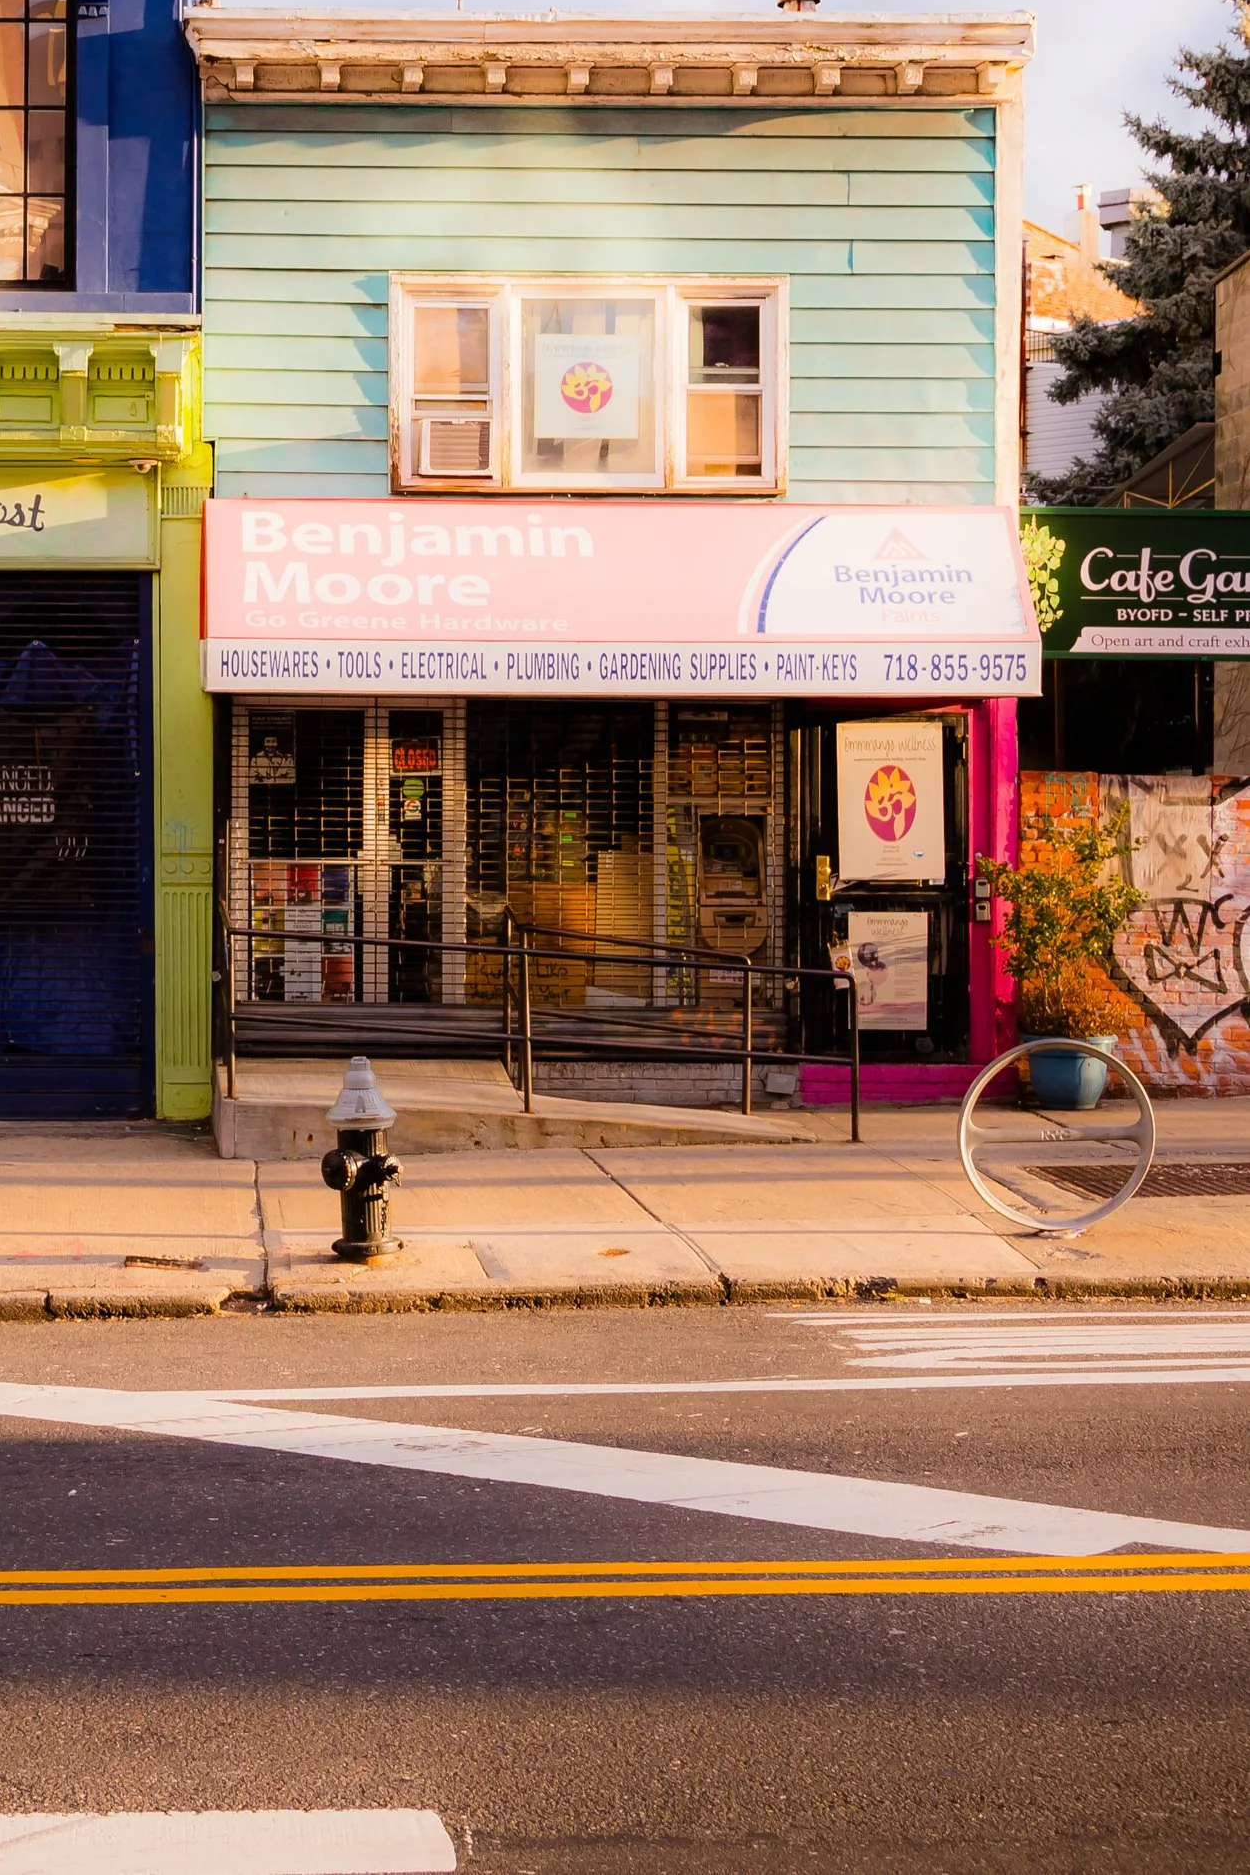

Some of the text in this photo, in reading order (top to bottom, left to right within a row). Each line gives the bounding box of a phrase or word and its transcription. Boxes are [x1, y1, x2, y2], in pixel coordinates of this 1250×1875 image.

[241, 511, 594, 566] Benjamin
[243, 561, 491, 607] Moore
[833, 565, 973, 588] Benjamin
[1080, 547, 1175, 603] Cafe
[859, 587, 956, 605] Moore
[244, 610, 569, 633] Go Greene Hardware
[881, 608, 940, 624] Paints
[1117, 608, 1173, 622] BYOFD
[1193, 608, 1229, 622] SELF
[1091, 634, 1130, 649] Open
[1134, 636, 1154, 648] art
[1158, 635, 1184, 648] and
[1188, 634, 1220, 648] craft
[220, 650, 319, 679] HOUSEWARES
[337, 651, 382, 679] TOOLS
[401, 652, 487, 680] ELECTRICAL
[506, 653, 580, 681] PLUMBING
[599, 653, 681, 681] GARDENING
[690, 653, 757, 681] SUPPLIES
[883, 654, 1027, 682] 718-855-9575
[394, 748, 437, 770] CLOSED
